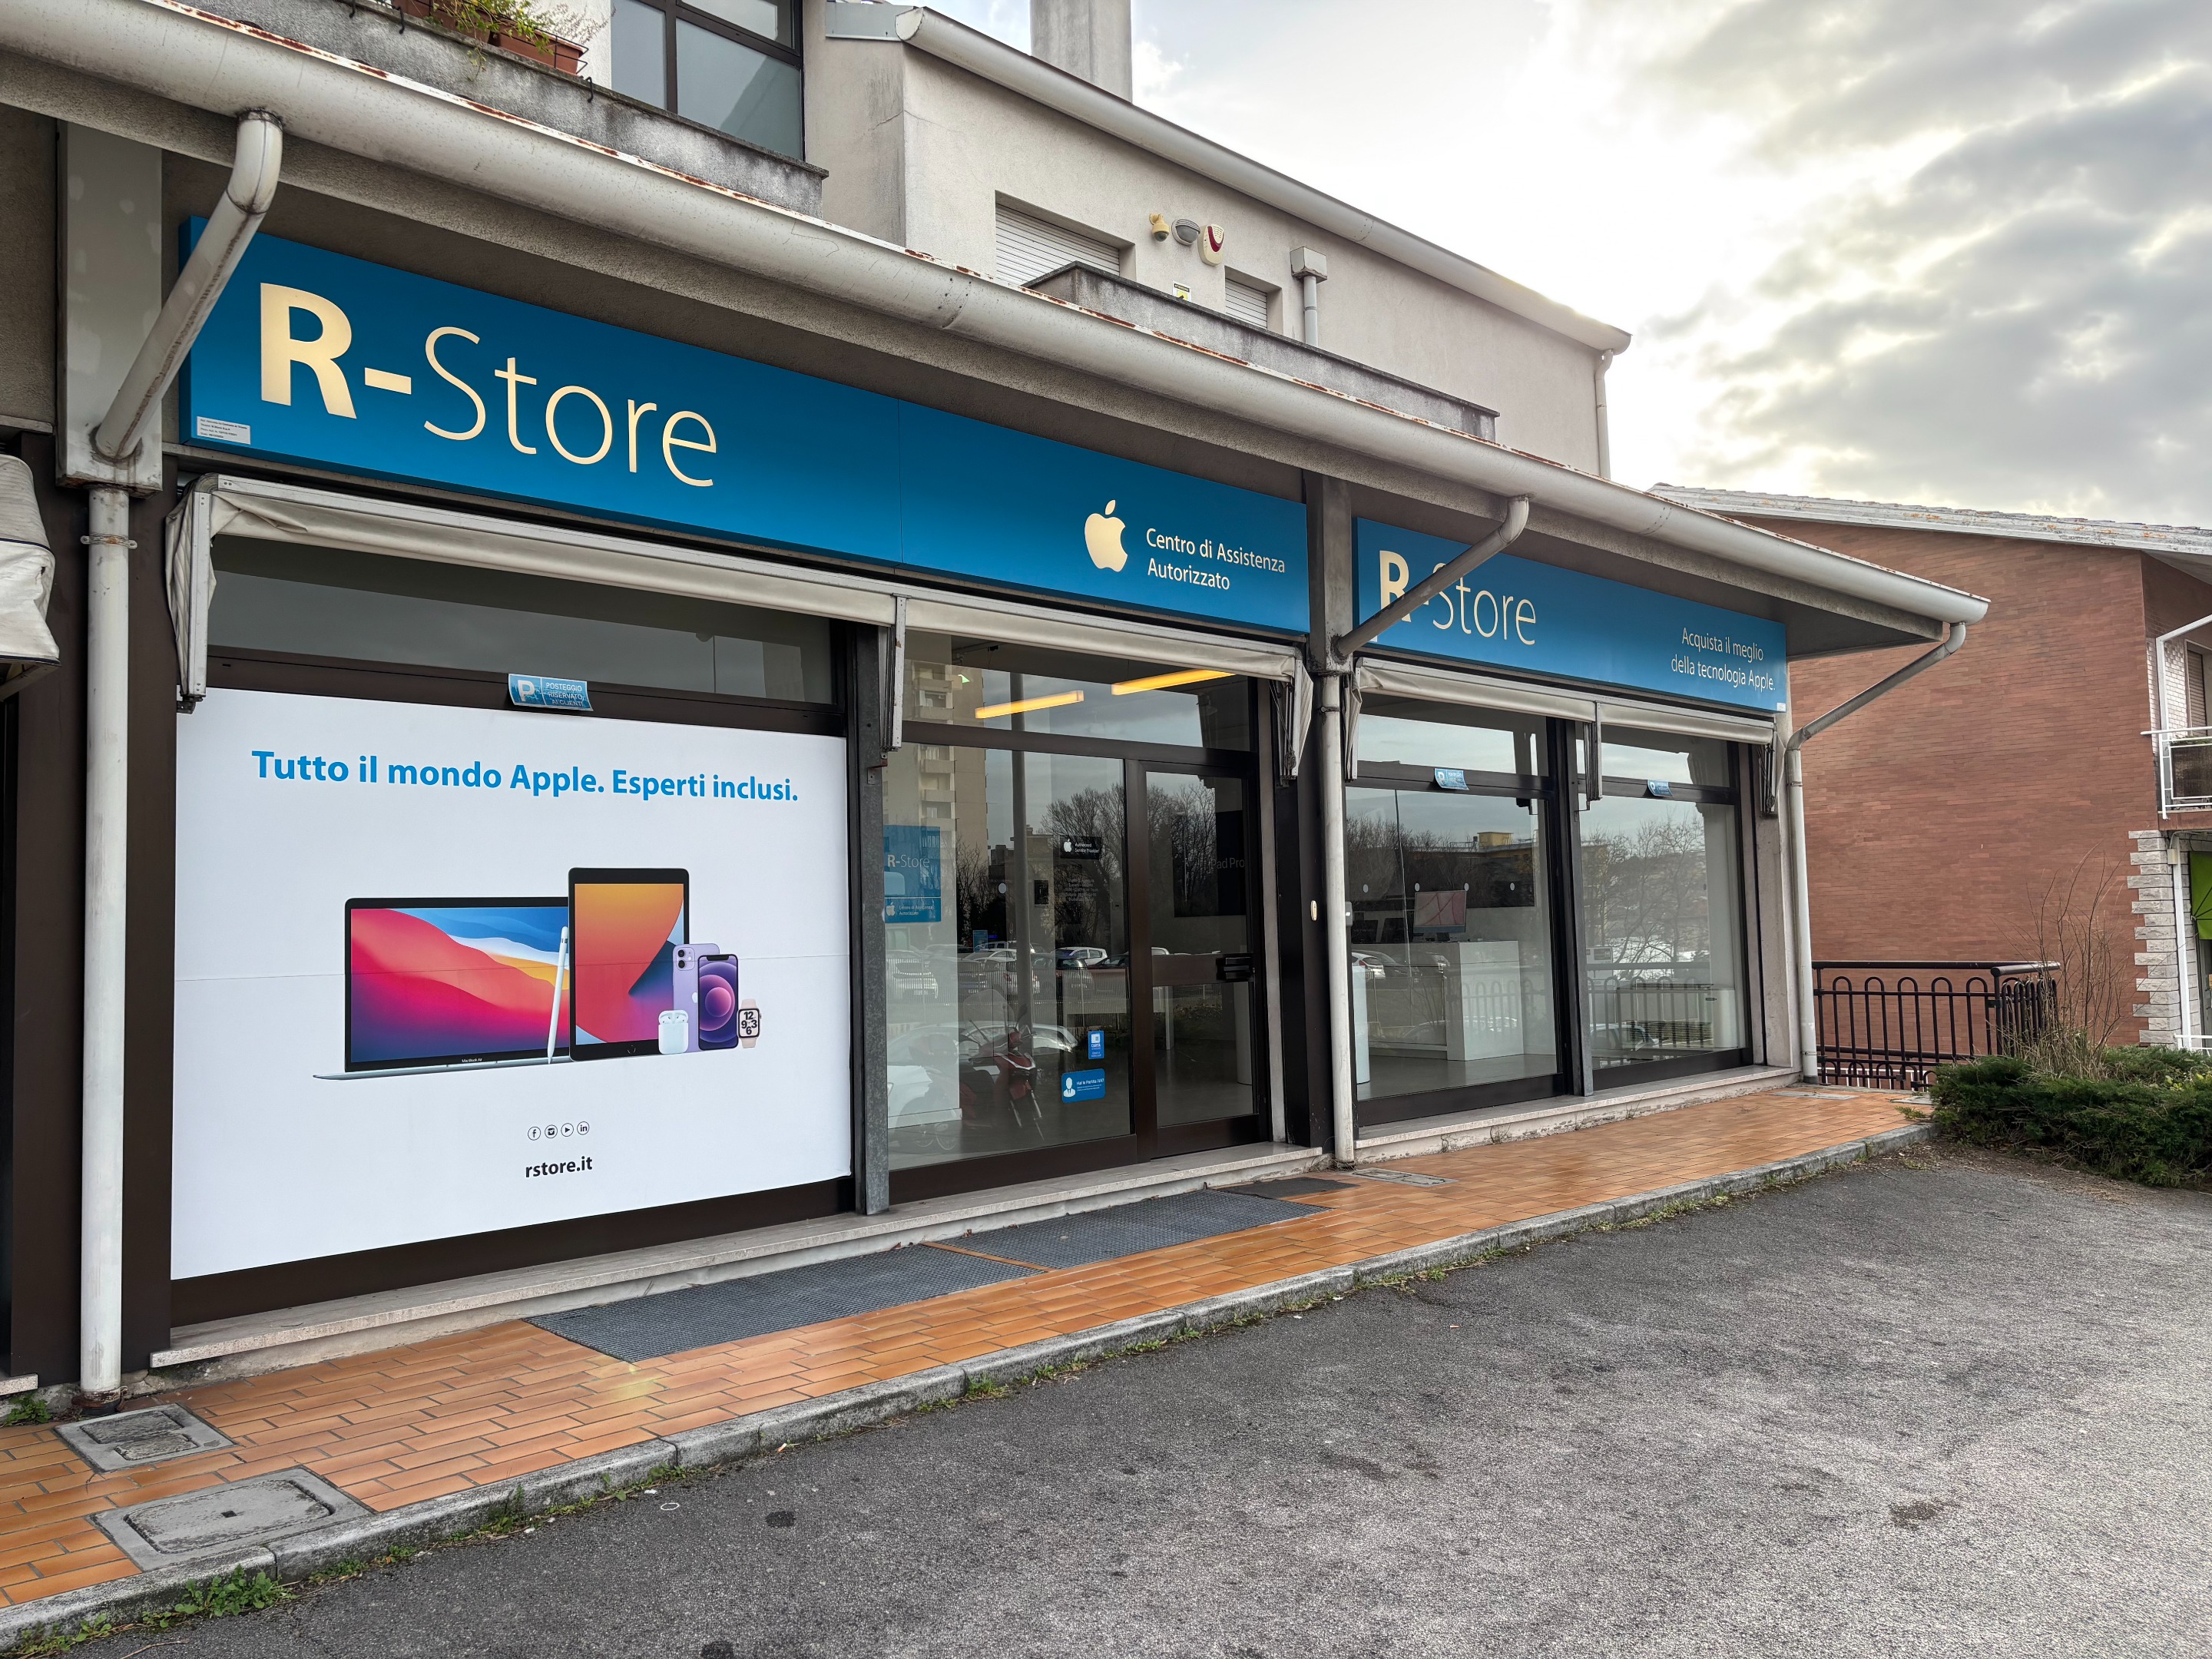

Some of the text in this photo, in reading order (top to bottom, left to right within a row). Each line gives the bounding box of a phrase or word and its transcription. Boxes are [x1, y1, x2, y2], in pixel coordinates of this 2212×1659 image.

[260, 282, 717, 488] R-Store
[1146, 528, 1285, 574] Centro di Assistenza
[1147, 558, 1230, 591] Autorizzato
[1379, 550, 1536, 645] RStore
[1681, 627, 1763, 664] Acquista il meglio
[1671, 654, 1776, 693] della tecnologia Apple.
[518, 680, 535, 702] P
[546, 682, 582, 692] POSTEGGIO
[548, 691, 583, 700] RISERVATO
[251, 750, 798, 801] Tutto il mondo Apple. Esperti inclusi.
[887, 854, 930, 868] R-Store
[1229, 857, 1245, 868] Pro
[741, 1019, 757, 1029] 9 3
[743, 1011, 754, 1020] 12
[746, 1026, 752, 1035] 6
[525, 1156, 593, 1178] rstore.it
